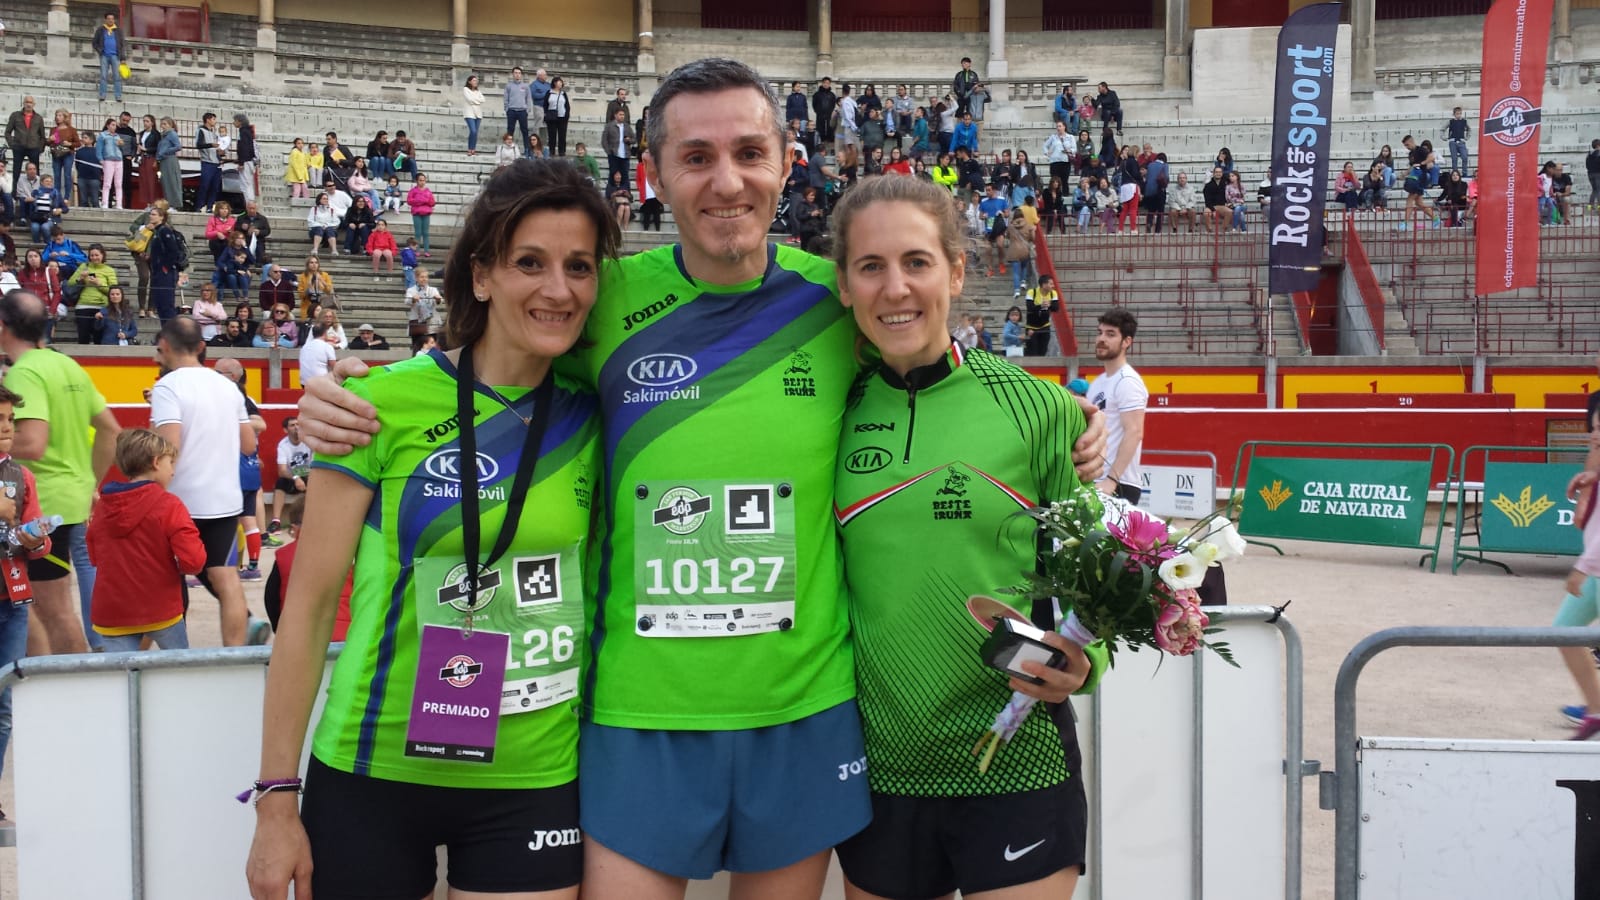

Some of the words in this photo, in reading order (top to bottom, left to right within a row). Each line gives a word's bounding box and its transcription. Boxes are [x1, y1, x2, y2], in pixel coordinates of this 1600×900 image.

[1323, 48, 1334, 77] .com
[1287, 44, 1327, 147] sport
[1502, 112, 1524, 127] edp
[1287, 147, 1316, 164] the
[1272, 167, 1314, 247] Rock
[639, 360, 686, 380] KIA
[623, 385, 700, 404] Sakimóvil
[1165, 382, 1173, 394] 1
[1369, 380, 1377, 393] 1
[1581, 382, 1589, 393] 1
[1399, 397, 1412, 405] 20
[423, 408, 480, 443] Jom
[439, 455, 489, 476] KA
[851, 452, 883, 469] KIA
[1140, 472, 1151, 487] N
[1176, 474, 1194, 490] DN
[423, 482, 505, 501] Sakióvil
[1303, 481, 1344, 498] CAJA
[1347, 483, 1412, 502] RURAL
[671, 501, 692, 517] edp
[932, 500, 973, 511] BESTE
[1299, 499, 1320, 514] DE
[1324, 500, 1407, 519] NAVARRA
[1557, 509, 1575, 526] D
[645, 556, 785, 595] 10127
[505, 625, 574, 670] 126
[422, 701, 490, 719] PREMIADO
[528, 828, 581, 851] Jom
